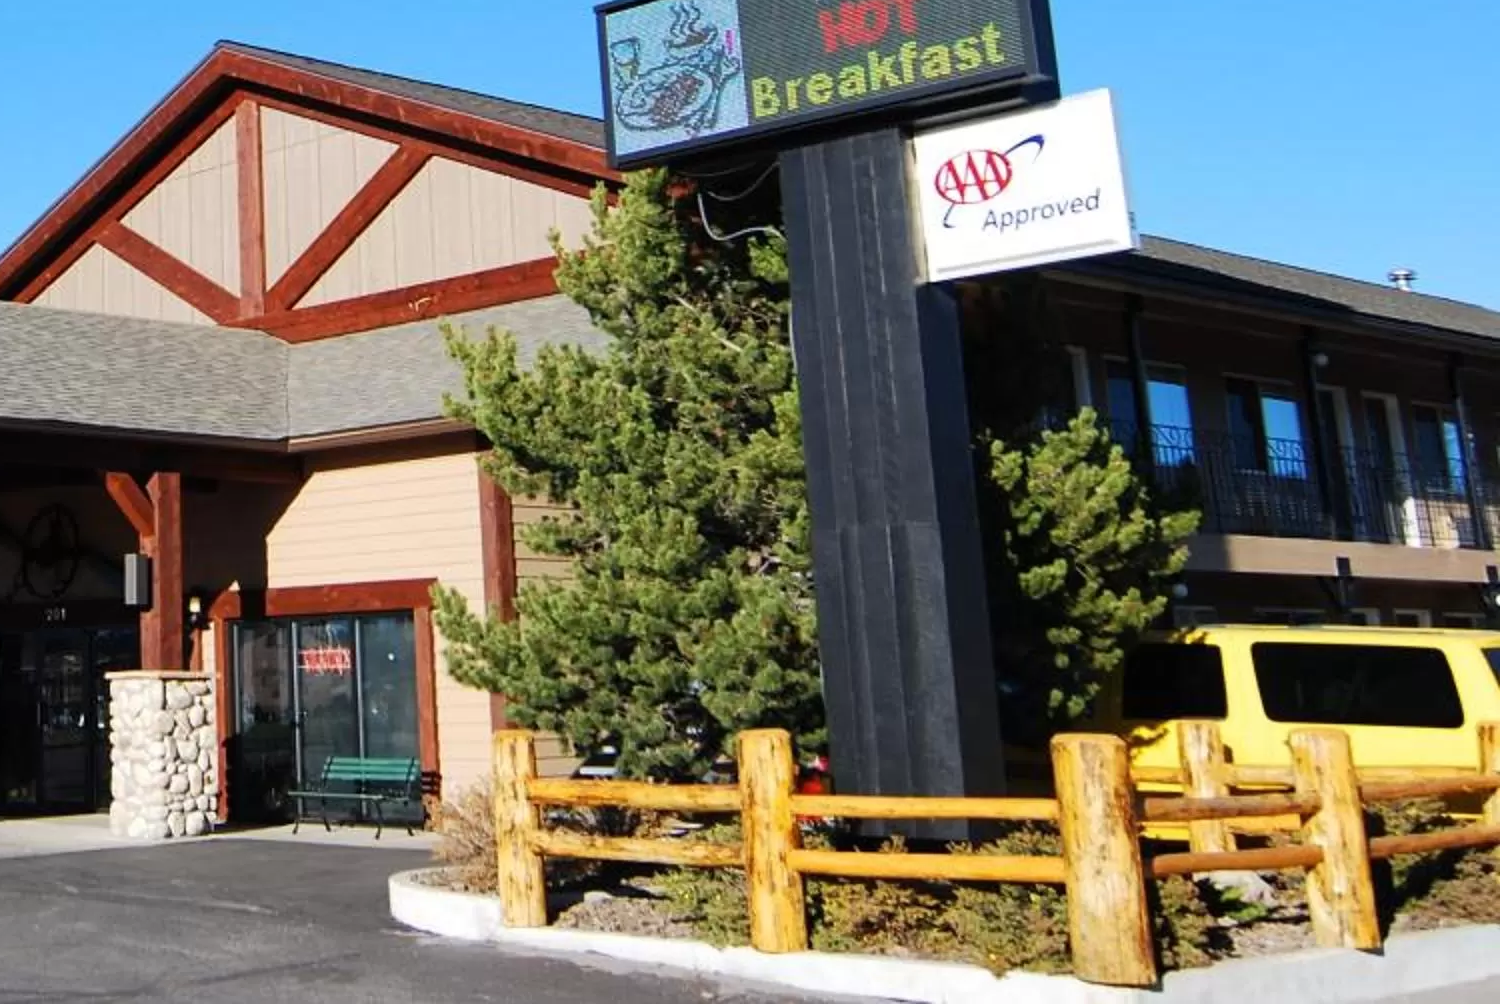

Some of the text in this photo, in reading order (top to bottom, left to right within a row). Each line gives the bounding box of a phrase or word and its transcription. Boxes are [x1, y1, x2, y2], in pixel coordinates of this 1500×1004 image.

[751, 21, 1005, 118] Breakfast
[938, 150, 1010, 203] AAA
[982, 188, 1101, 233] Approved
